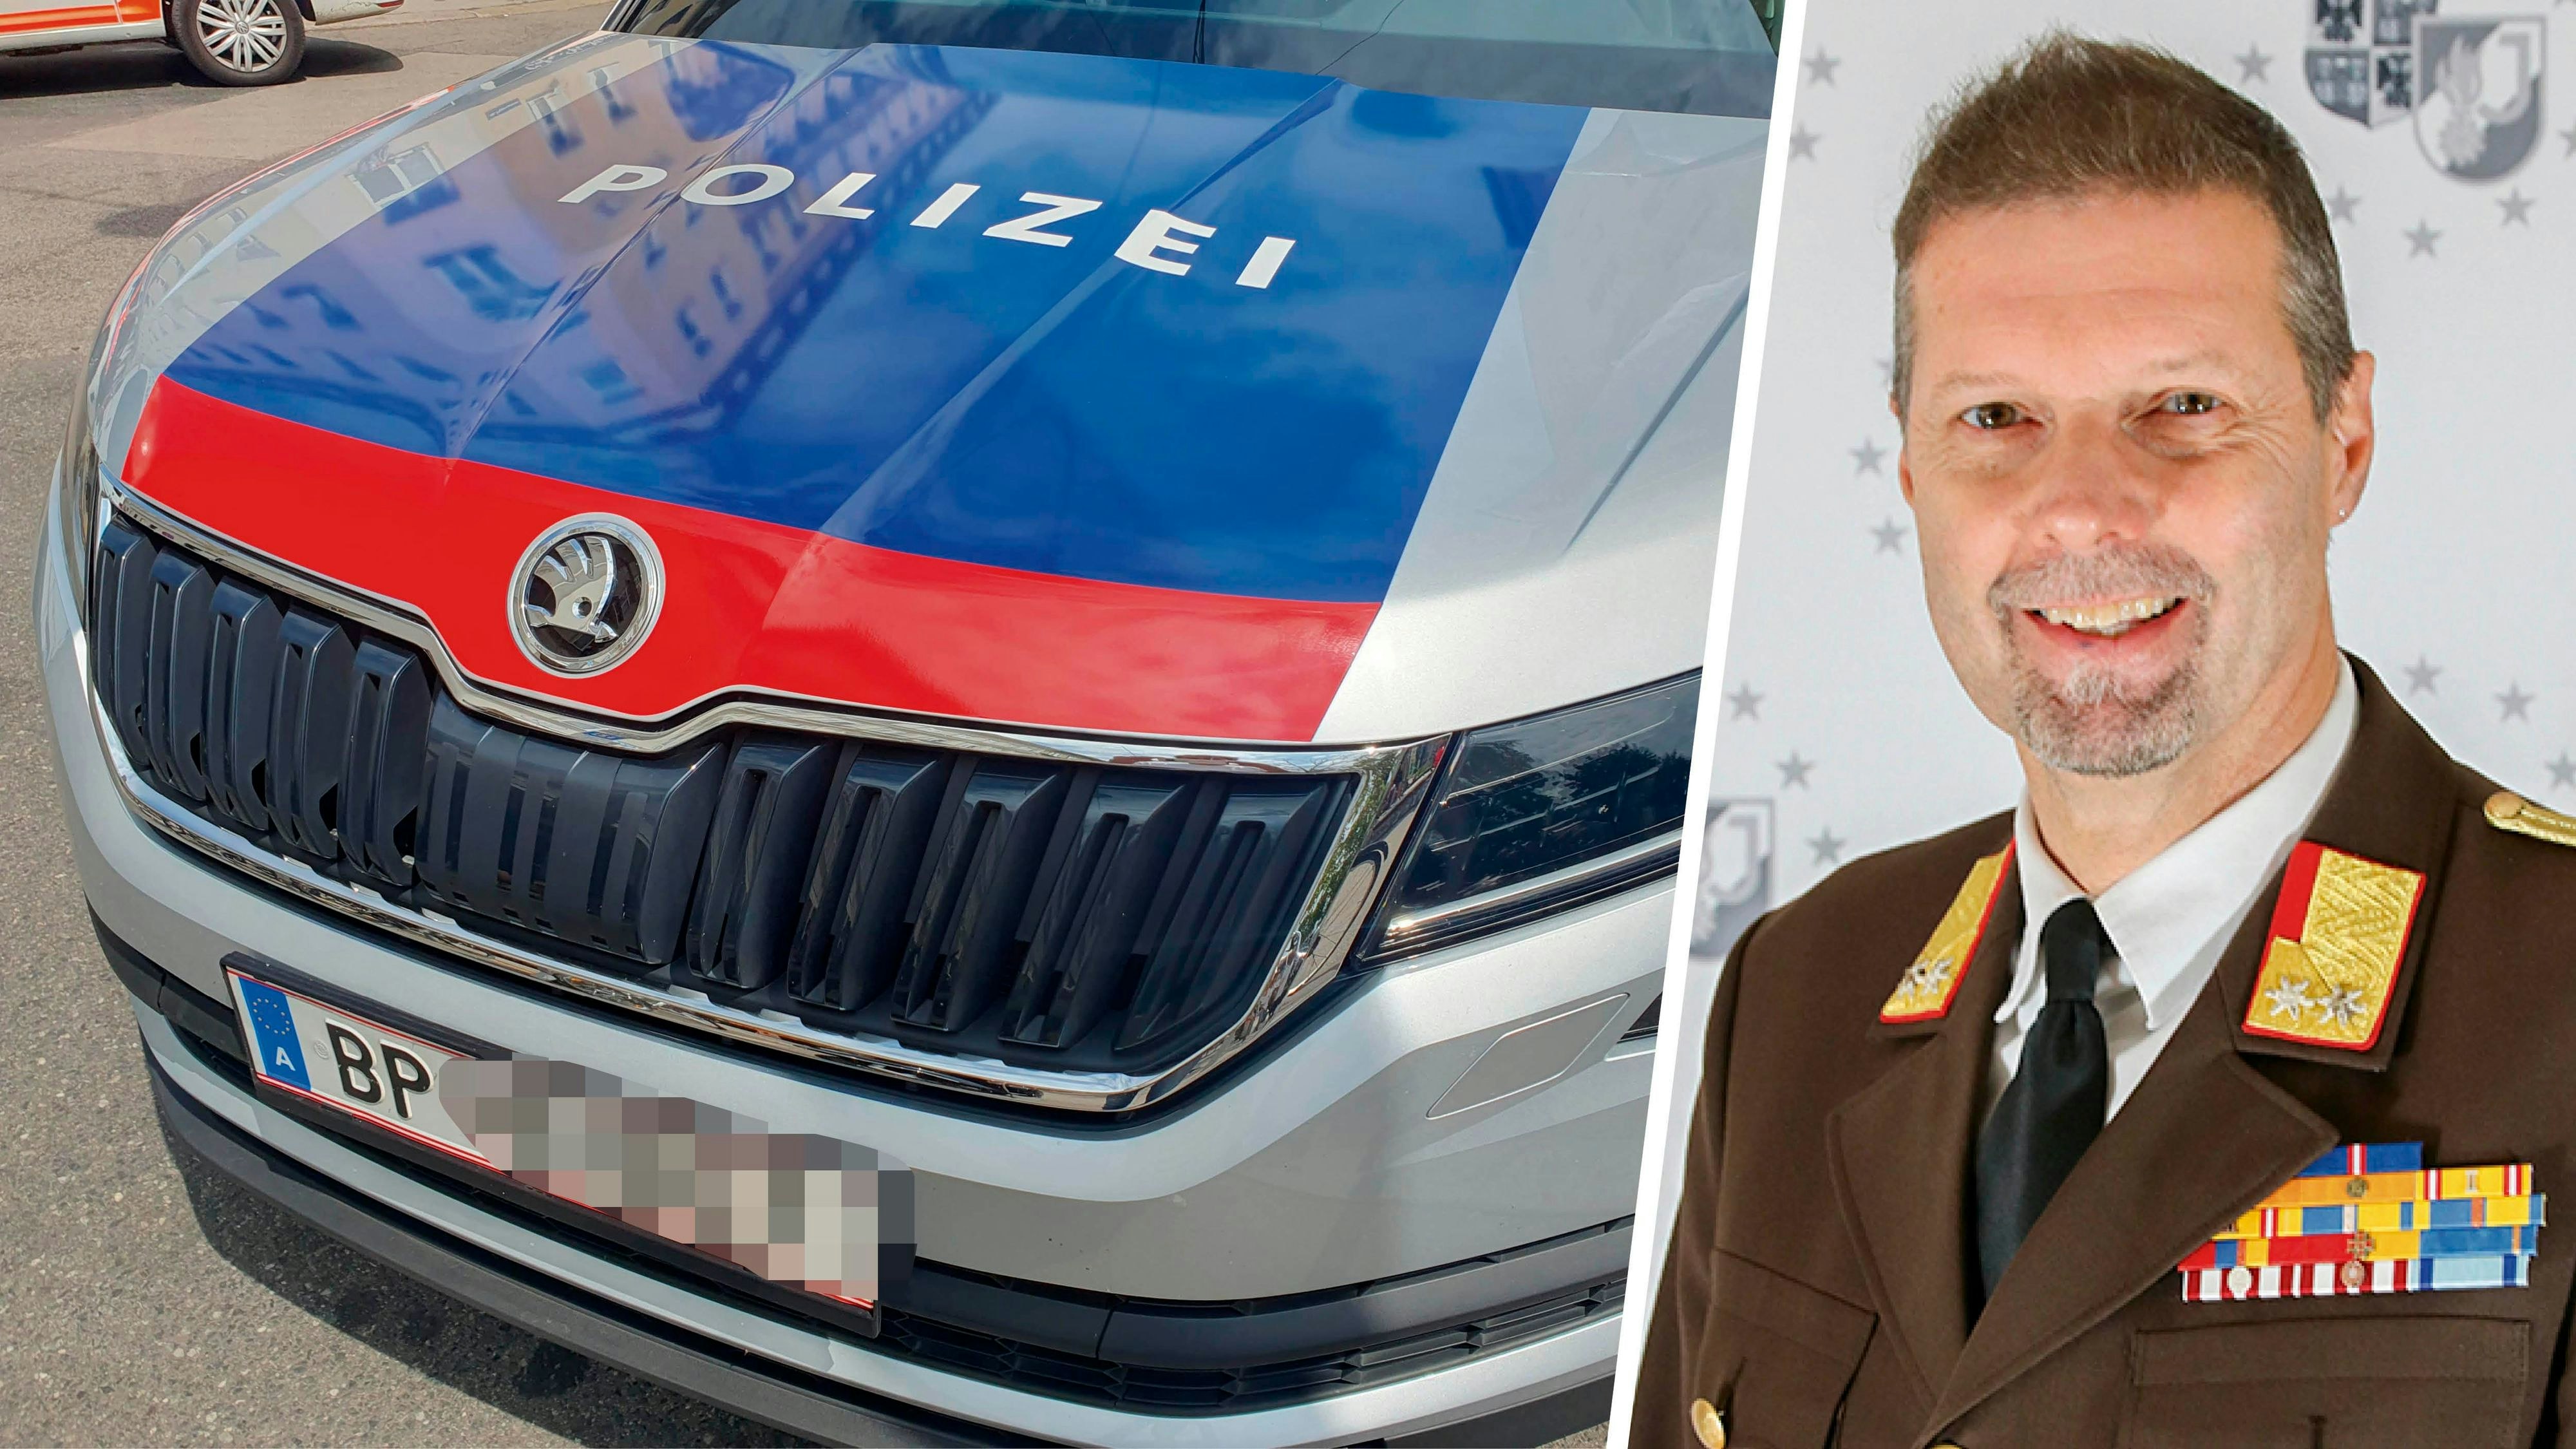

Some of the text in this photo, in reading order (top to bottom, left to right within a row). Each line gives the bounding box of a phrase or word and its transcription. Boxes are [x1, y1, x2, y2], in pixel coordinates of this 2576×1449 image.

[558, 164, 1296, 289] POLIZEI
[276, 1046, 296, 1071] A
[325, 1018, 434, 1119] BP
